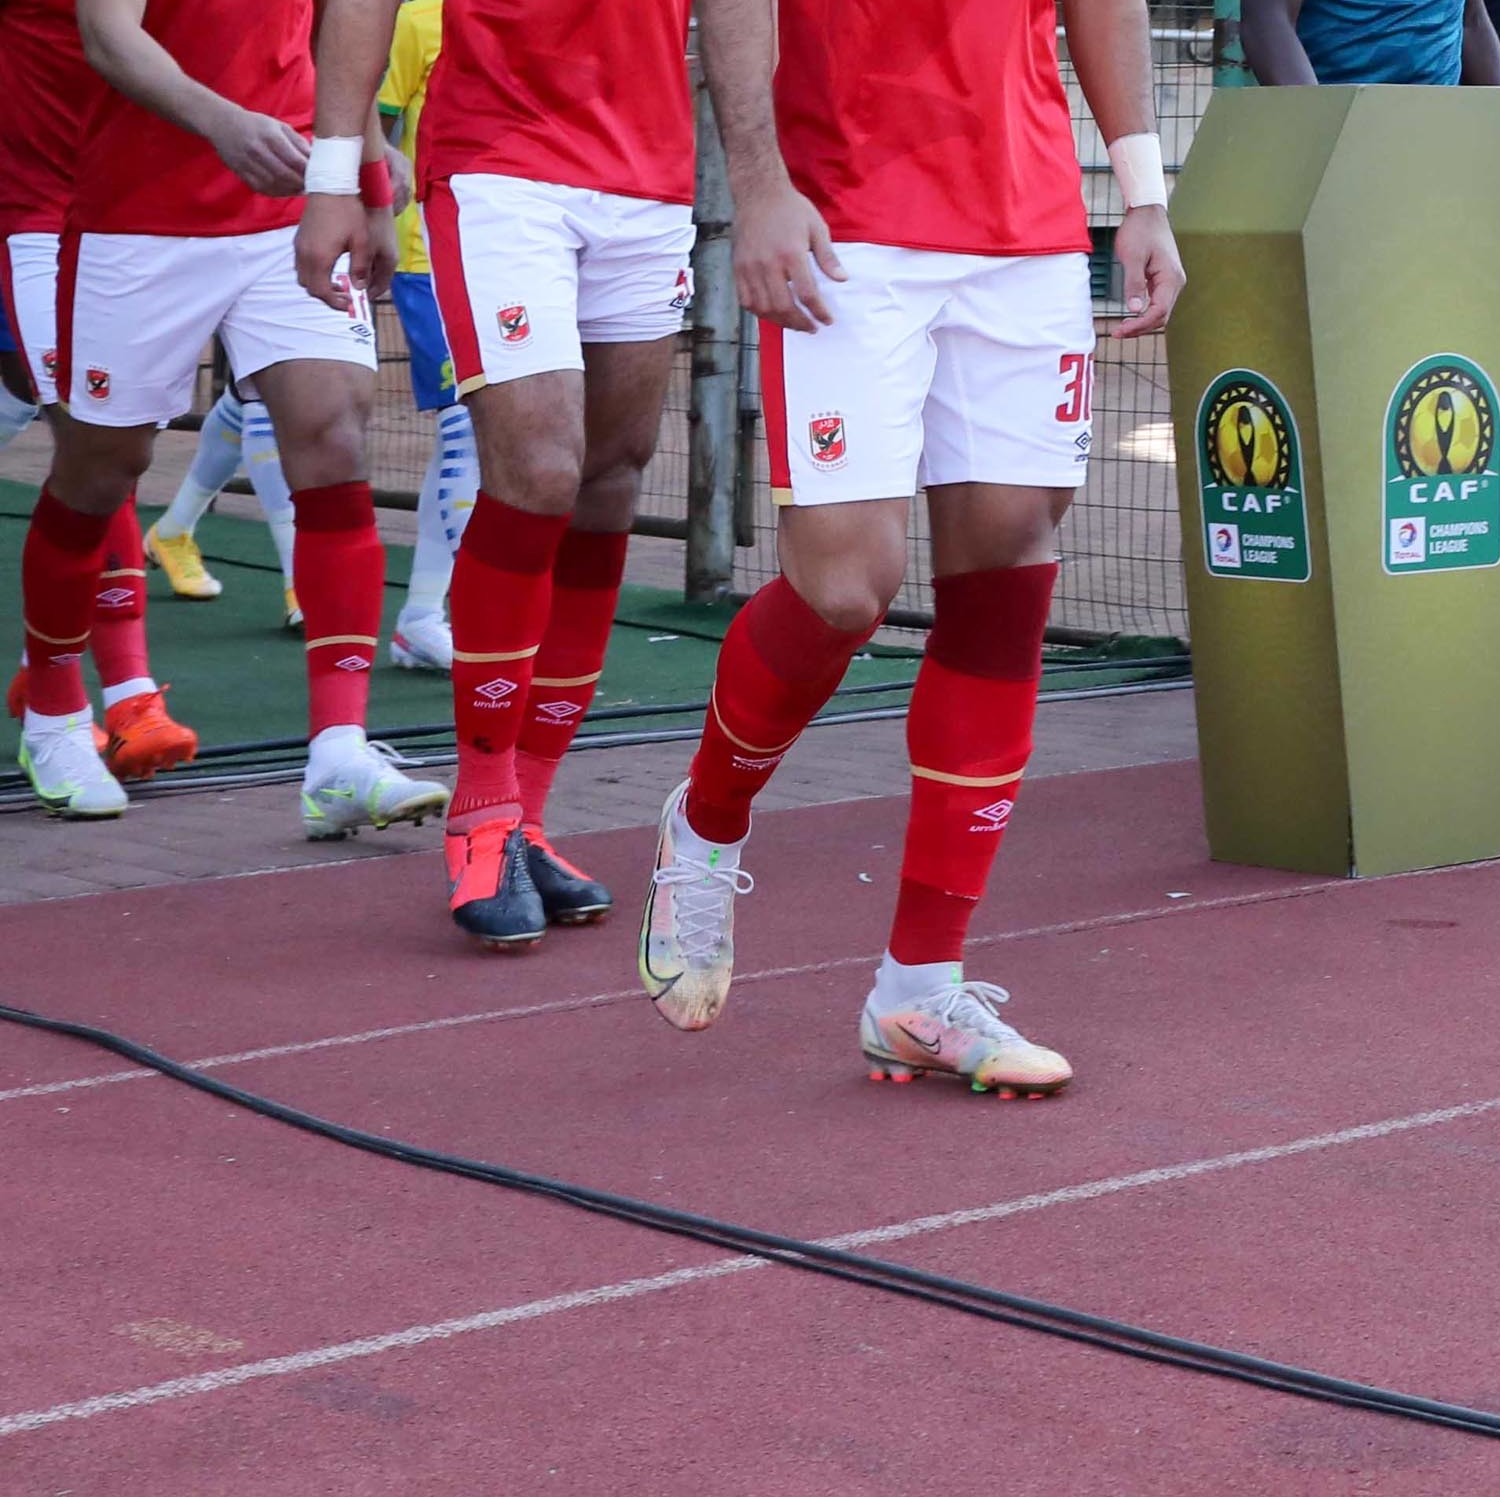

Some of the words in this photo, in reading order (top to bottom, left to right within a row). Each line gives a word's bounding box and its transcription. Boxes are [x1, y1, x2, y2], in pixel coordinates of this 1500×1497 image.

[1409, 480, 1478, 504] CAF
[1221, 492, 1283, 513] CAF
[1429, 521, 1490, 538] CHAMPIONS
[1241, 533, 1296, 550] CHAMPIONS
[1429, 538, 1469, 554] LEAGUE
[1214, 555, 1240, 564] TOTAL
[1242, 550, 1279, 564] LEAGUE
[473, 700, 512, 709] umbro
